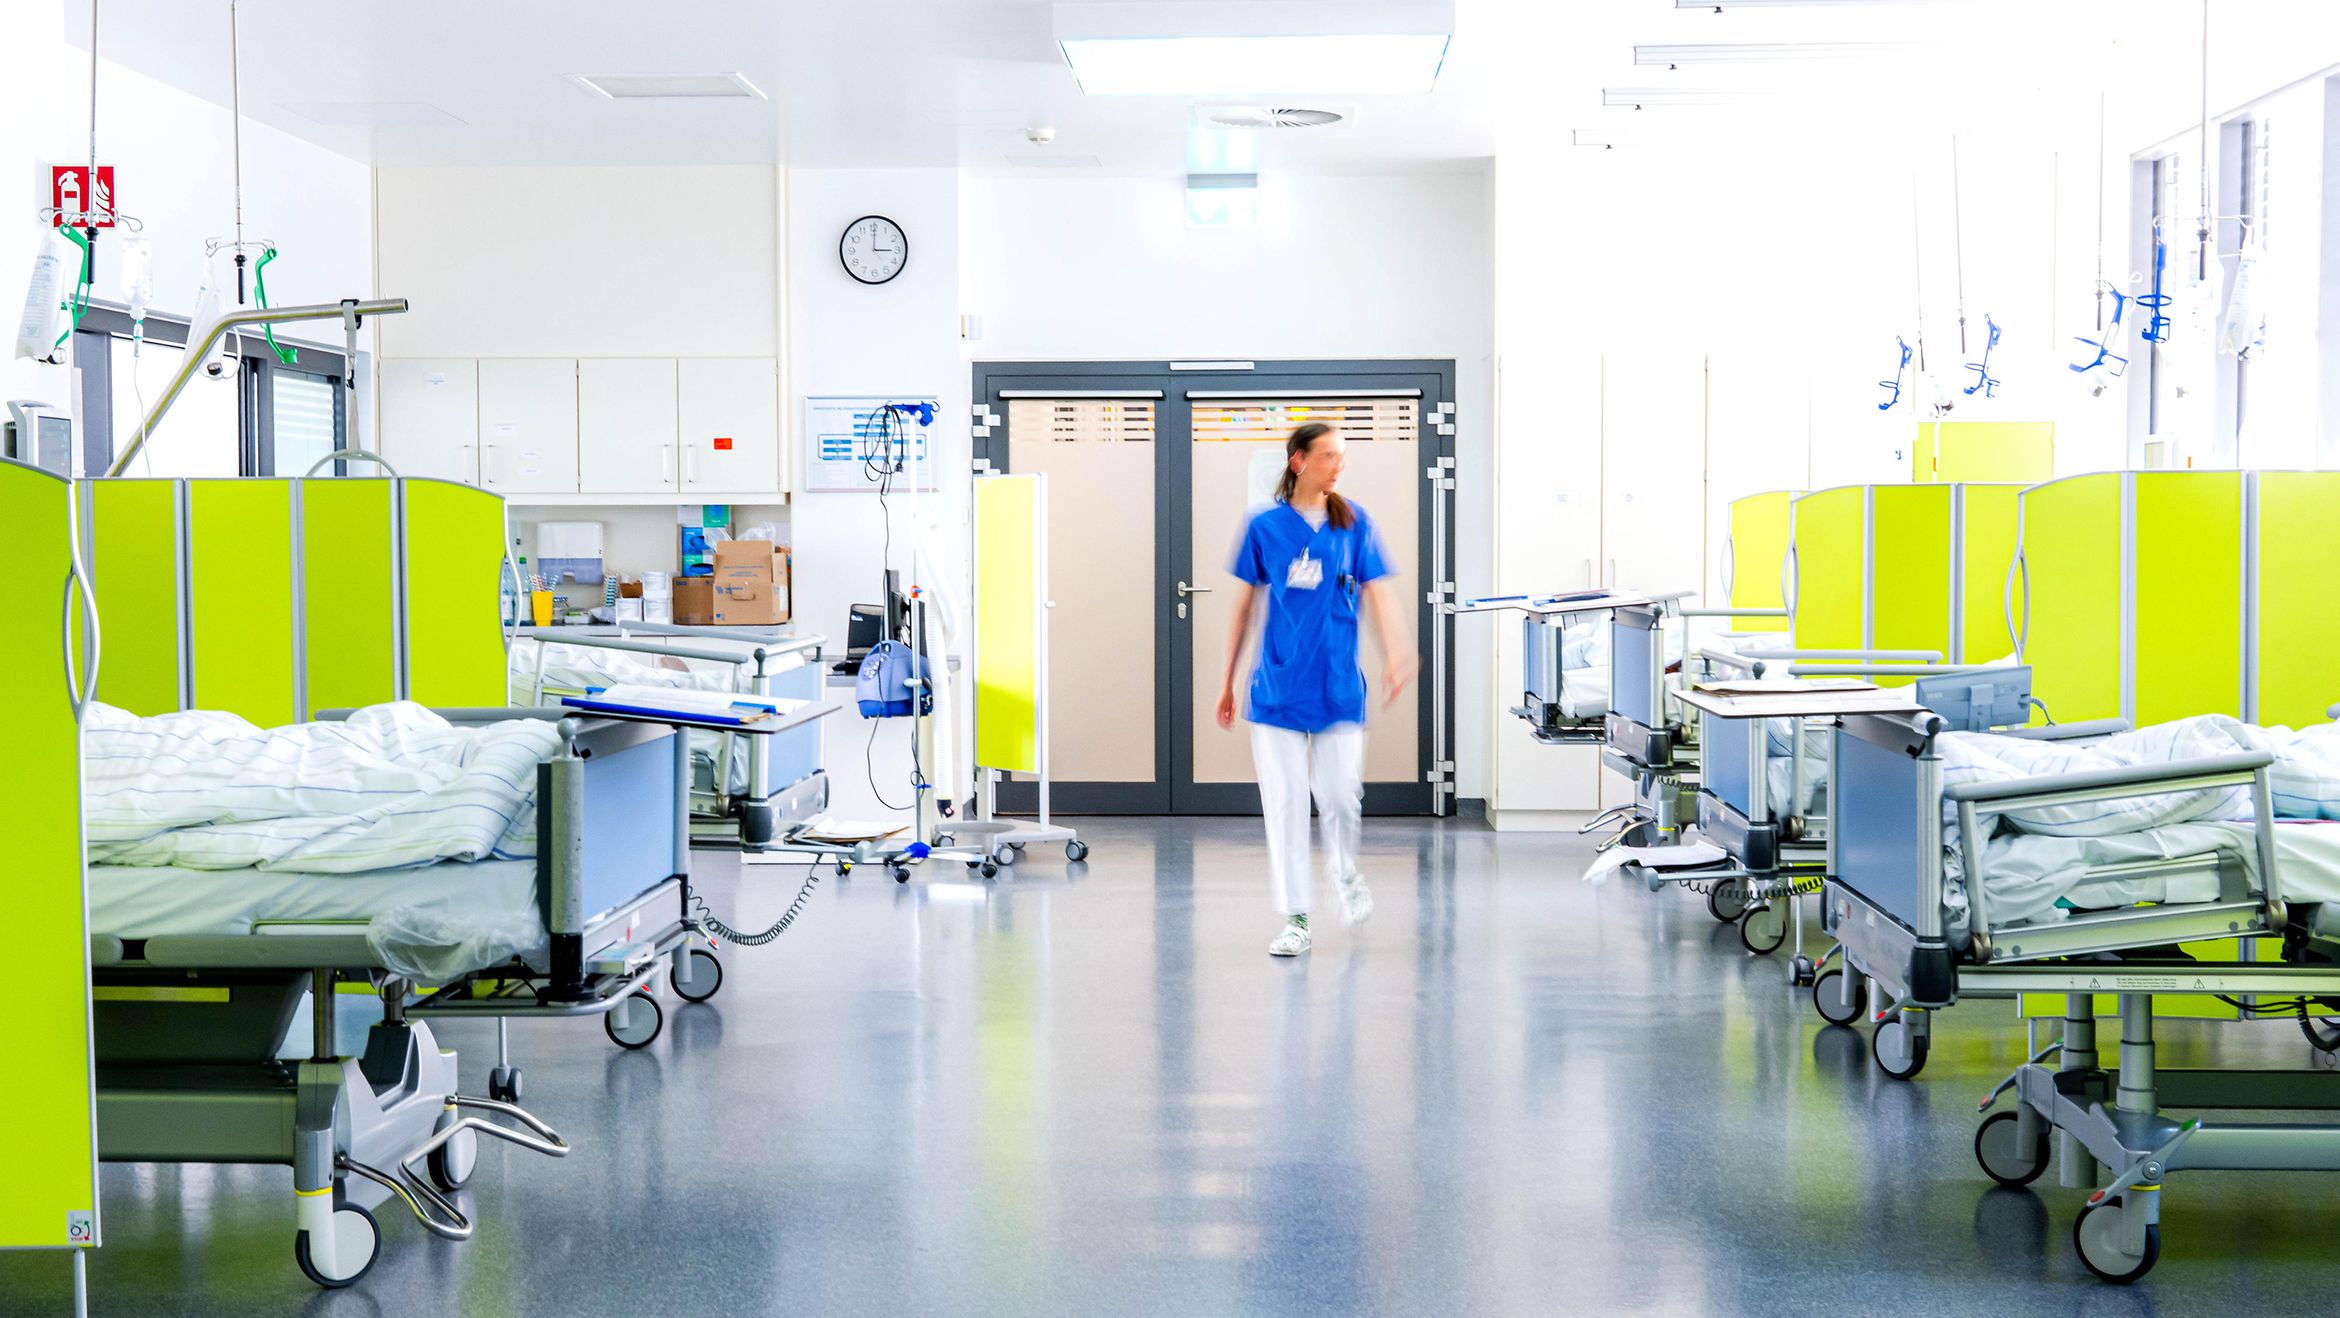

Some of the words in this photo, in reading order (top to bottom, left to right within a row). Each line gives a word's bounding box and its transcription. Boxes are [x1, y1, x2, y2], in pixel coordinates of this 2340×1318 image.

[884, 226, 887, 234] 1
[890, 234, 898, 242] 2
[848, 246, 856, 255] 9
[860, 266, 868, 274] 7
[871, 269, 879, 277] 6
[882, 266, 890, 274] 5
